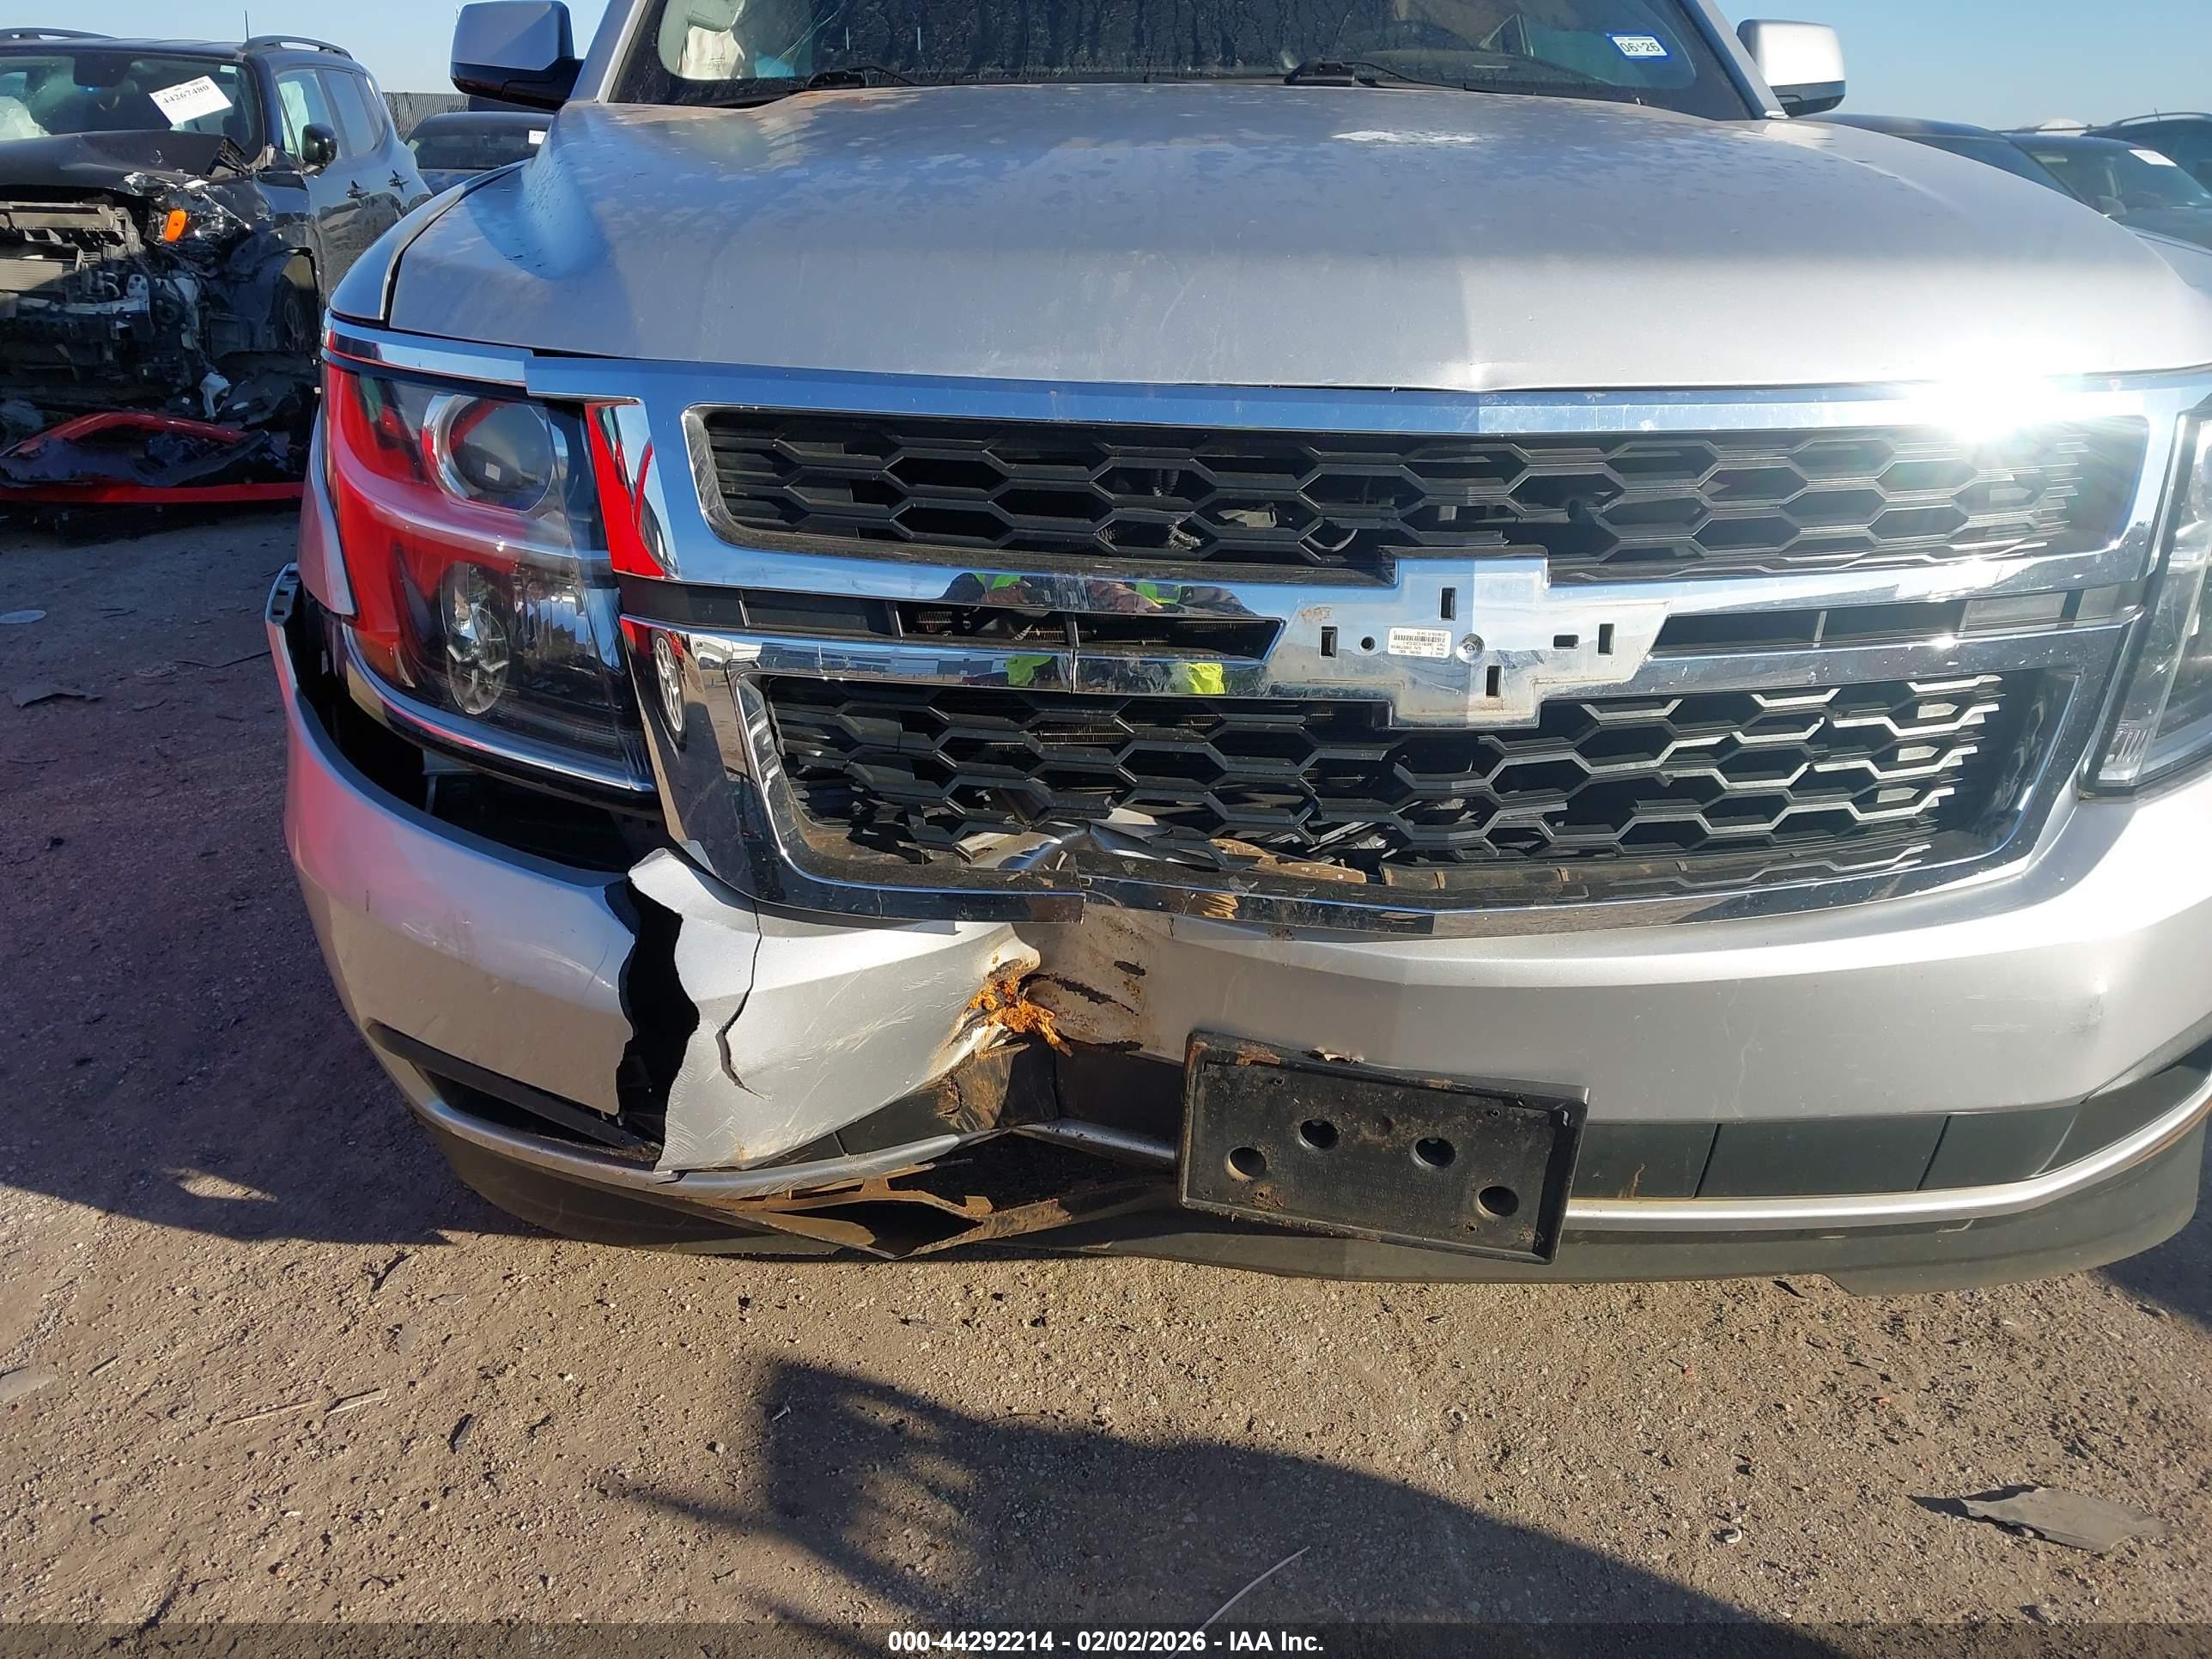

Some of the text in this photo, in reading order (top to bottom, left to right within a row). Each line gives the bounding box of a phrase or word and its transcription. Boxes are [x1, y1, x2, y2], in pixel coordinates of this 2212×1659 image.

[1620, 42, 1661, 52] 06 26
[163, 84, 210, 104] 44267480
